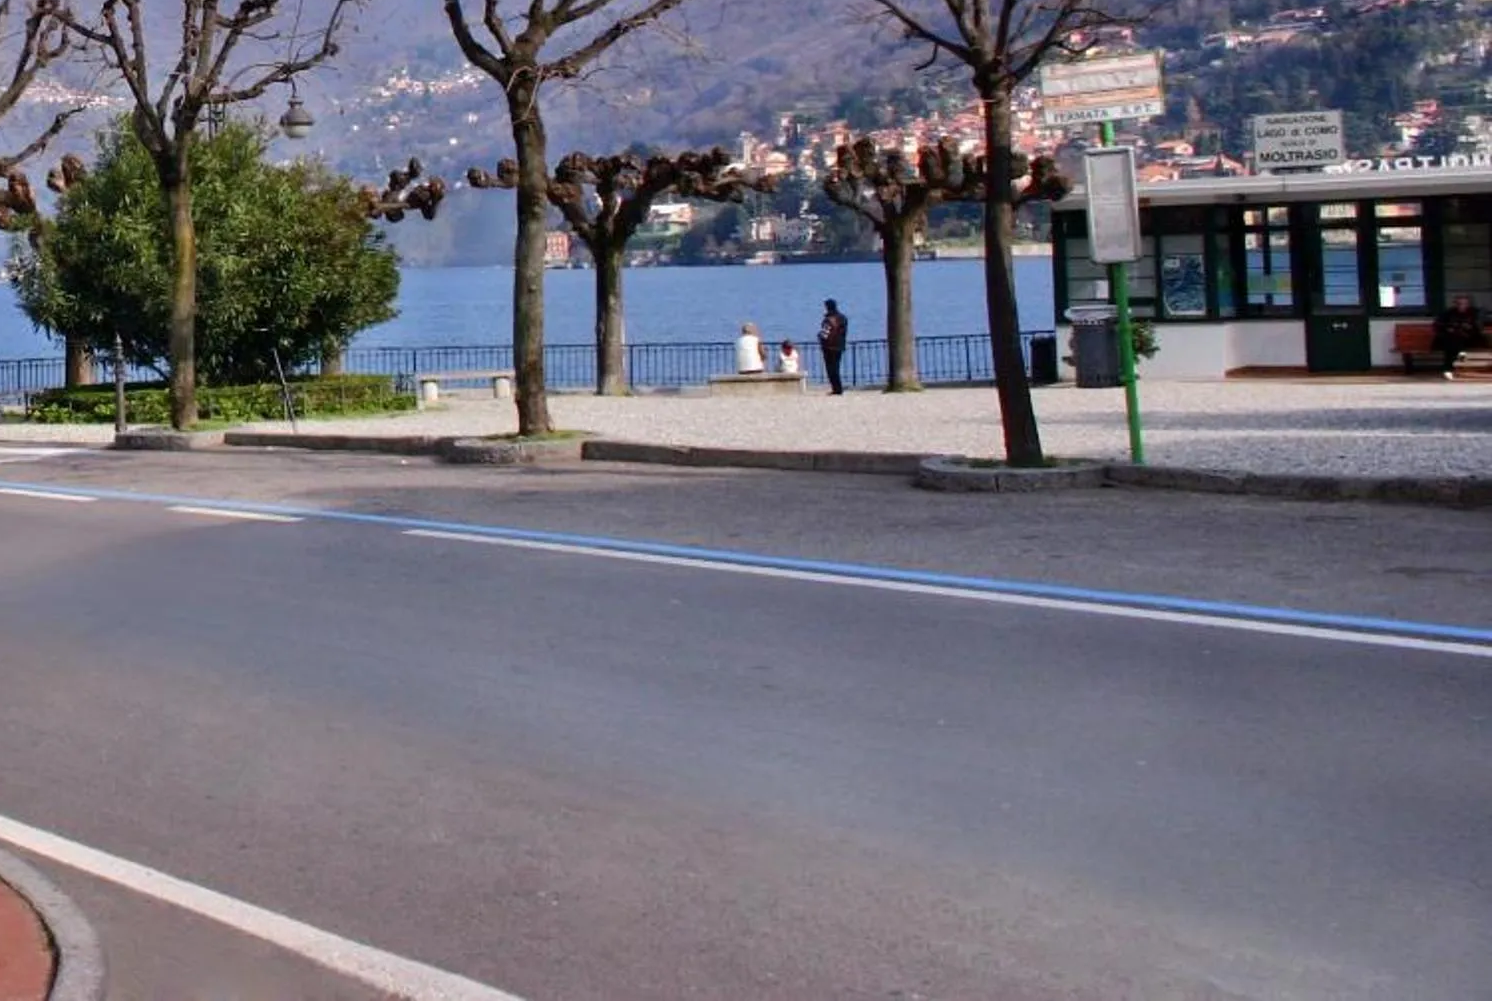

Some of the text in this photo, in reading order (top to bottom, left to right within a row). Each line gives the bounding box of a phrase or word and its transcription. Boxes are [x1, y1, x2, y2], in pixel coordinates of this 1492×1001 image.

[1257, 127, 1286, 138] LAGO
[1304, 125, 1339, 136] COMO
[1260, 148, 1338, 162] MOLTRASIO
